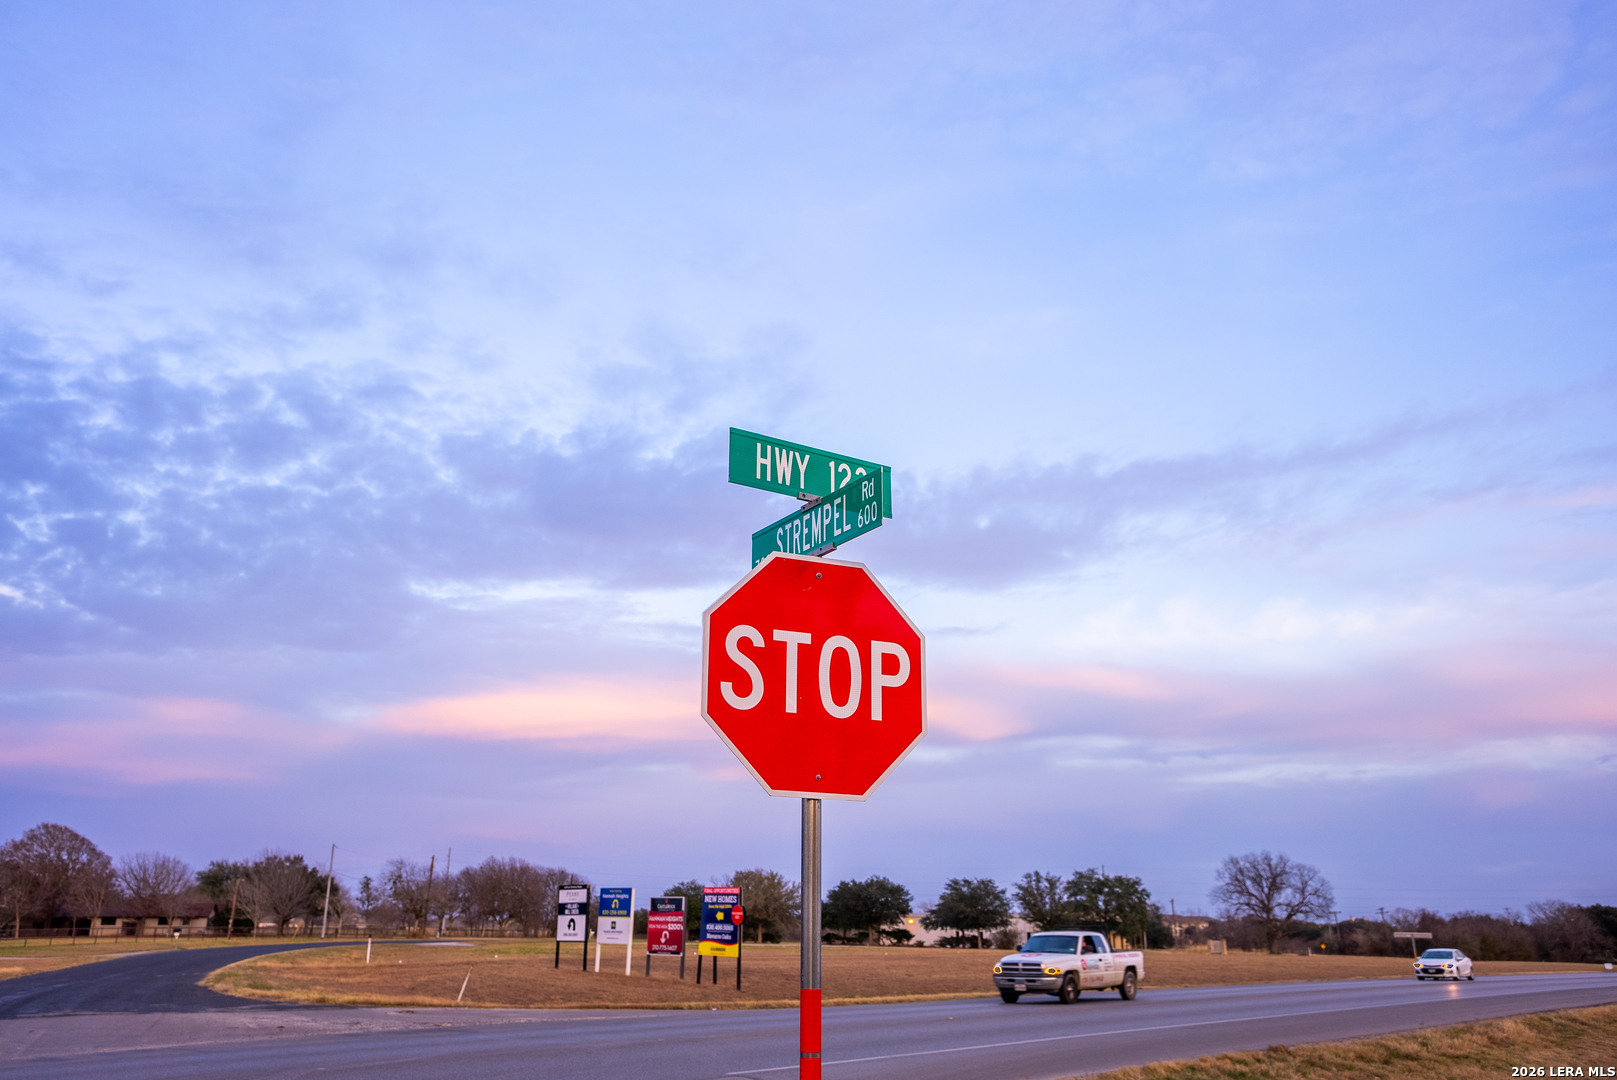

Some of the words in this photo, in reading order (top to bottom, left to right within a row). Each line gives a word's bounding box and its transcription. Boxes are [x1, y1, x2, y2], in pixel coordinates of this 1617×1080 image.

[756, 442, 810, 490] HWY
[861, 477, 875, 502] Rd
[776, 494, 851, 555] STREMPEL
[857, 501, 878, 528] 600
[720, 624, 911, 721] STOP
[704, 895, 717, 903] NEW
[717, 895, 737, 904] HOMES
